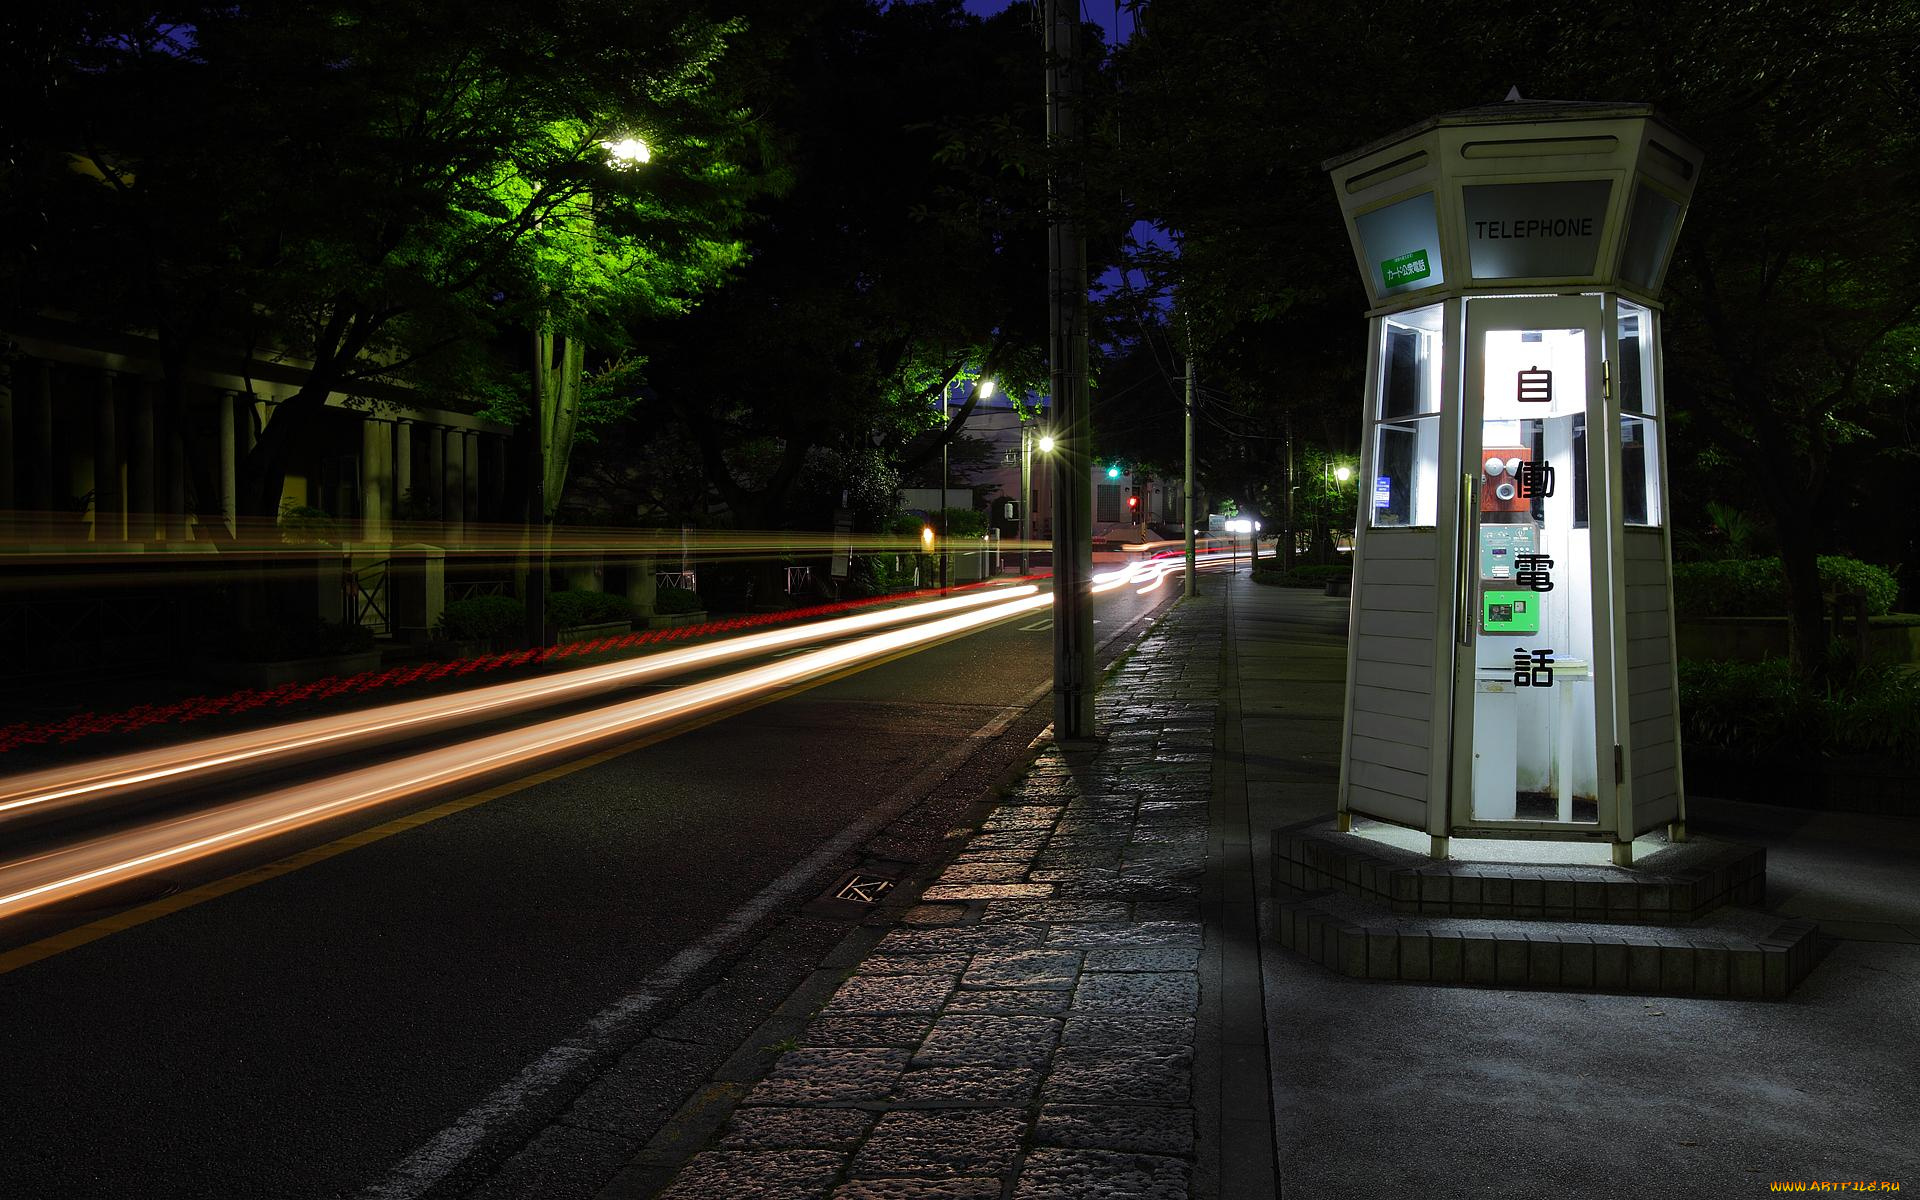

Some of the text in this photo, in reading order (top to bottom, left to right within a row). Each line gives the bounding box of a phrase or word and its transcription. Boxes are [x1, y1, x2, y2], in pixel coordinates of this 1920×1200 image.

[1475, 218, 1593, 239] TELEPHONE
[1514, 365, 1555, 688] 自働電話
